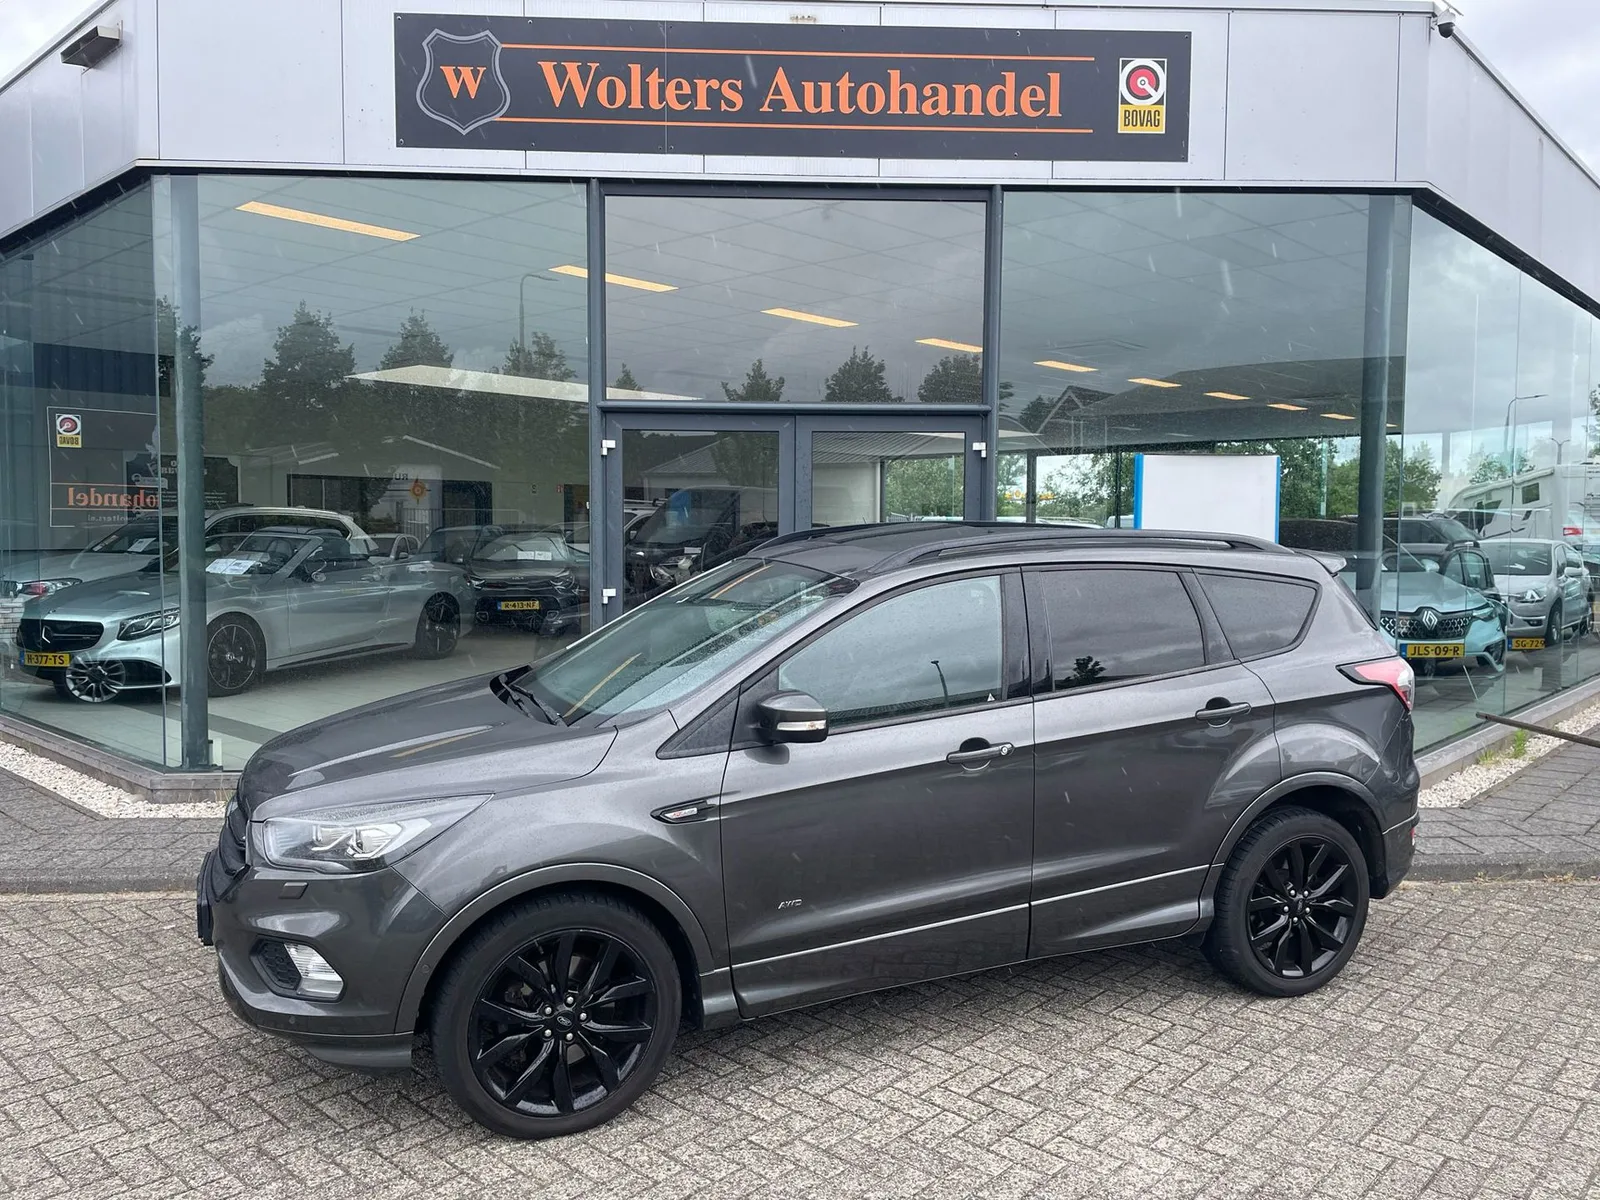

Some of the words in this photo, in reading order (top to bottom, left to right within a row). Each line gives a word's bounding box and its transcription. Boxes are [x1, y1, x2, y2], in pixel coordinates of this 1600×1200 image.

[440, 65, 487, 99] W
[537, 60, 744, 112] Wolters
[759, 66, 1063, 117] Autohandel
[1123, 109, 1161, 128] BOVAG
[27, 654, 65, 665] H-377-TS
[1410, 645, 1460, 656] JLS-09-R
